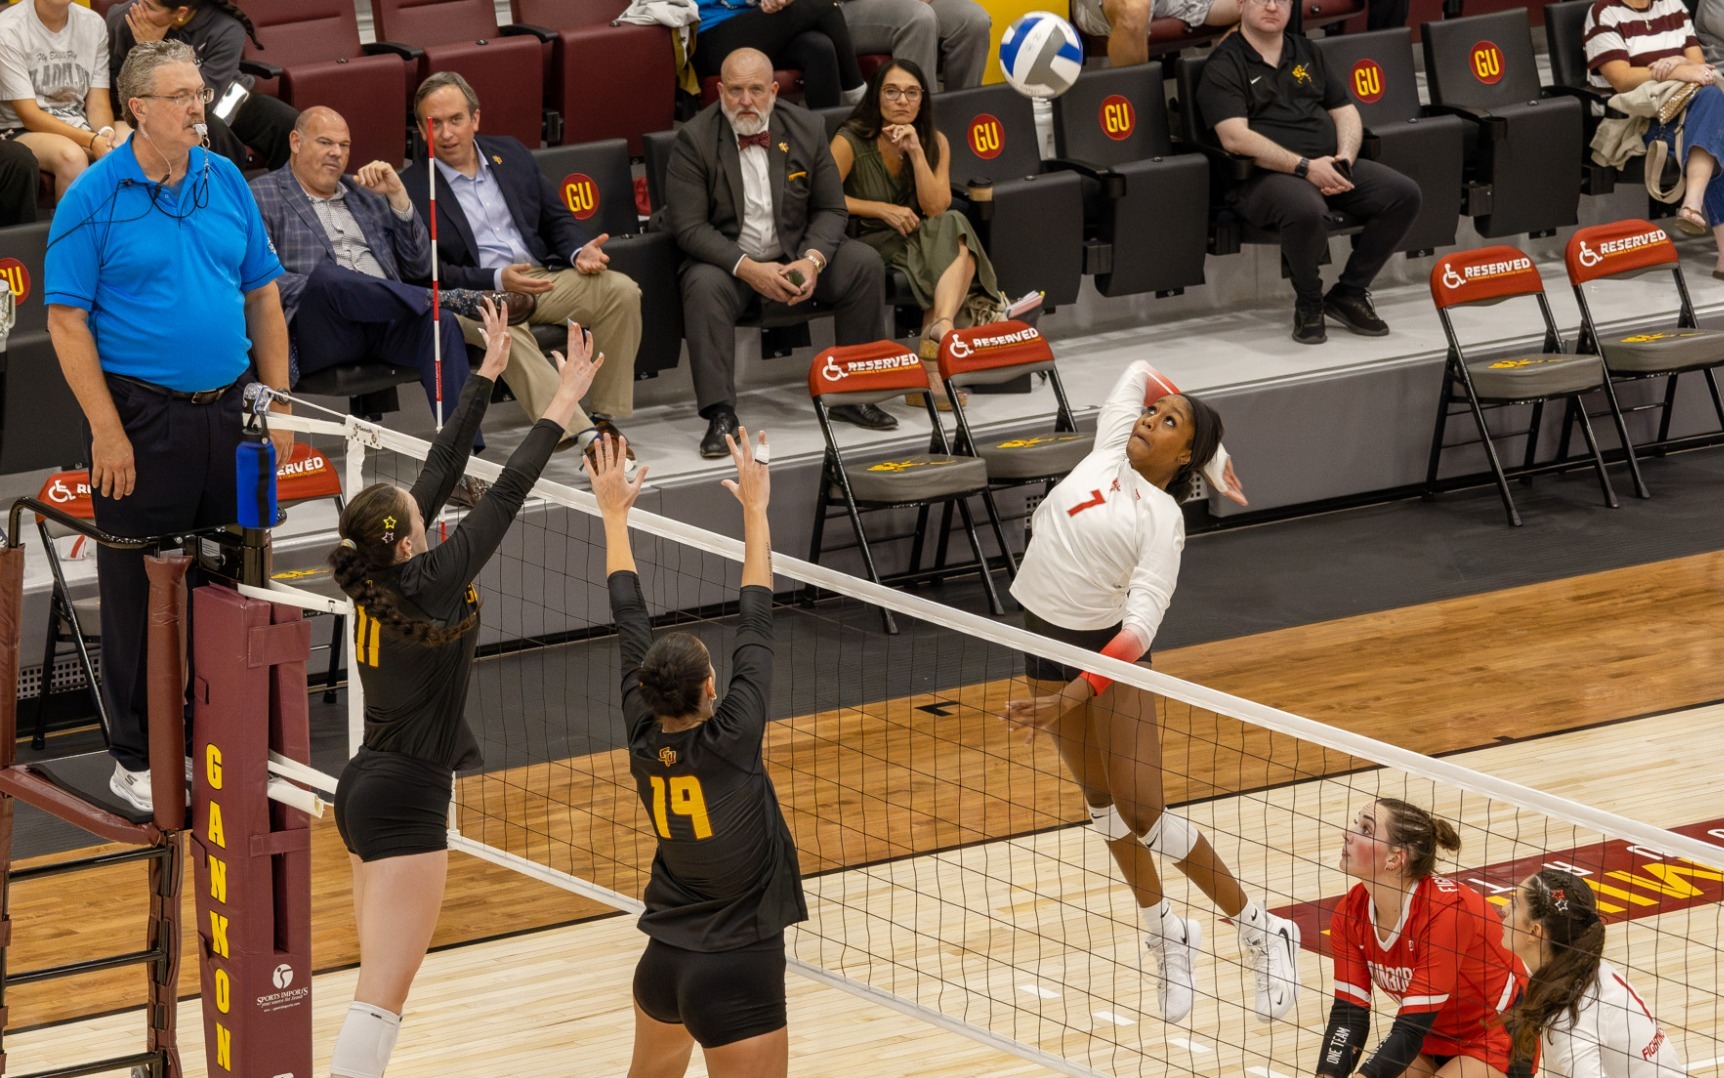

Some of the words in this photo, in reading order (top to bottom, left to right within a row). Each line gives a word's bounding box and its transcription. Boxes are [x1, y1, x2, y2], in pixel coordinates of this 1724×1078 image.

[1474, 48, 1500, 78] GU
[1354, 66, 1381, 96] GU
[1104, 103, 1130, 133] GU
[973, 121, 1000, 153] GU
[566, 181, 594, 212] GU
[1600, 229, 1667, 254] RESERVED
[1464, 257, 1531, 278] RESERVED
[972, 327, 1039, 348] RESERVED
[847, 352, 919, 372] RESERVED
[1066, 488, 1107, 518] 7
[649, 775, 713, 840] 19
[256, 992, 280, 1006] SPORTS
[281, 987, 309, 999] IMPORTS
[1330, 1026, 1351, 1047] TEAM
[1326, 1047, 1343, 1065] ONE
